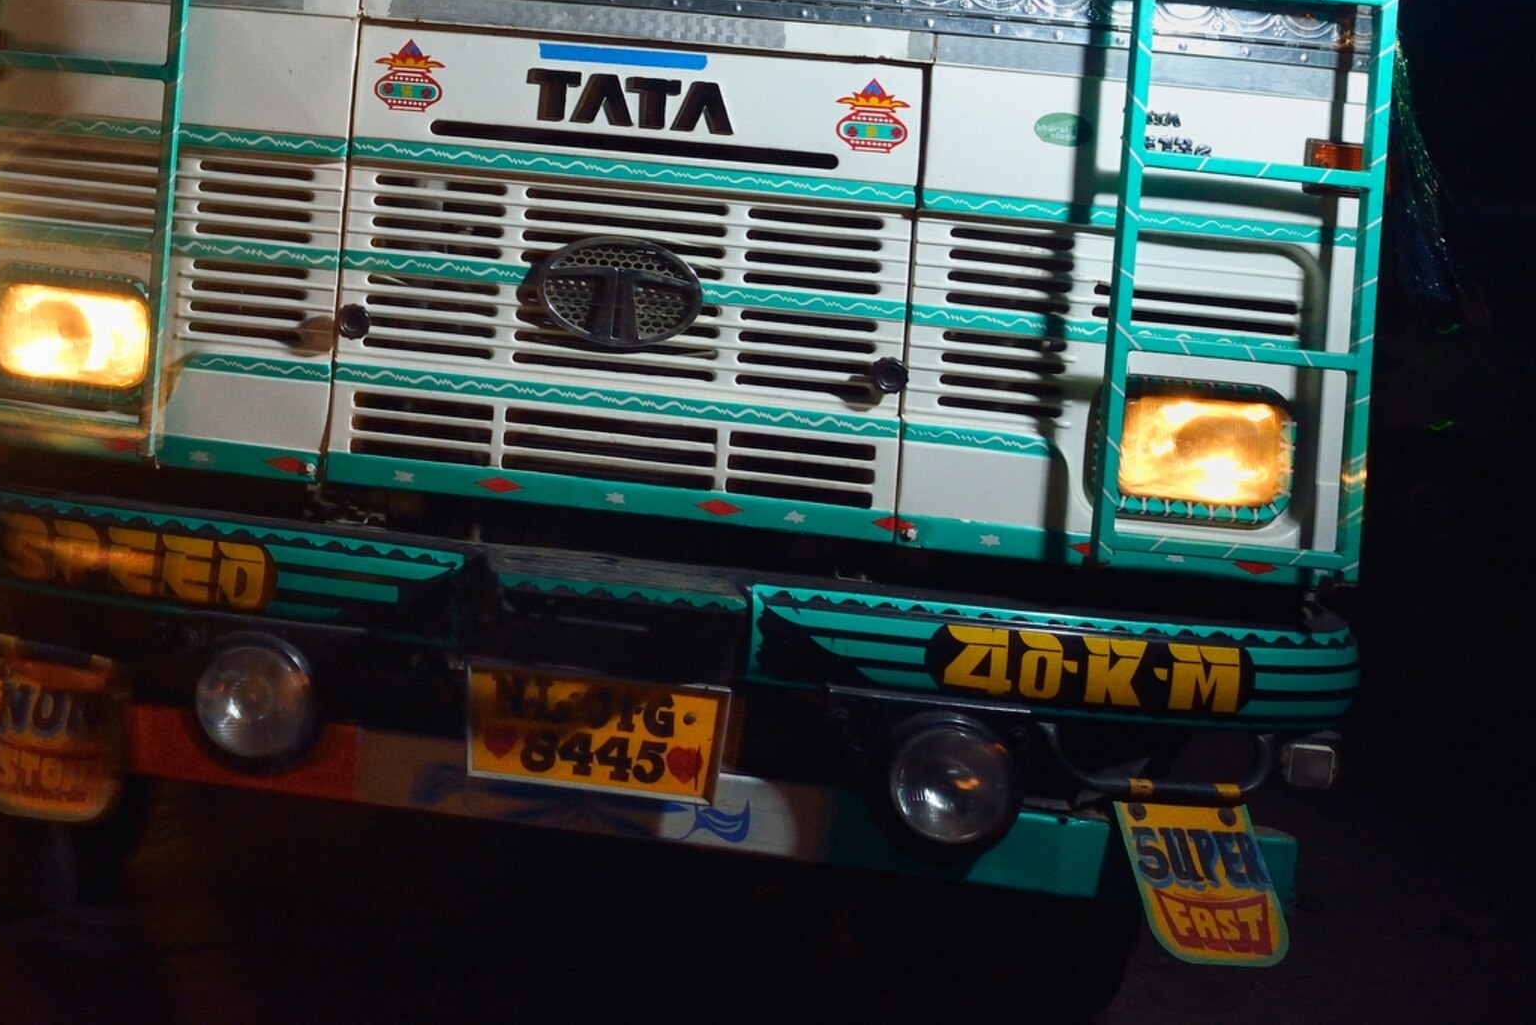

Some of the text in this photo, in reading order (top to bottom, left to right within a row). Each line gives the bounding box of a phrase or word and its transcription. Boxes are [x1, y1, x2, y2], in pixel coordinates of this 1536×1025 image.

[527, 68, 734, 135] TATA
[2, 512, 267, 607] SPEED
[520, 730, 668, 783] 8445
[1132, 826, 1272, 891] SUPER
[1170, 904, 1265, 945] FAST
